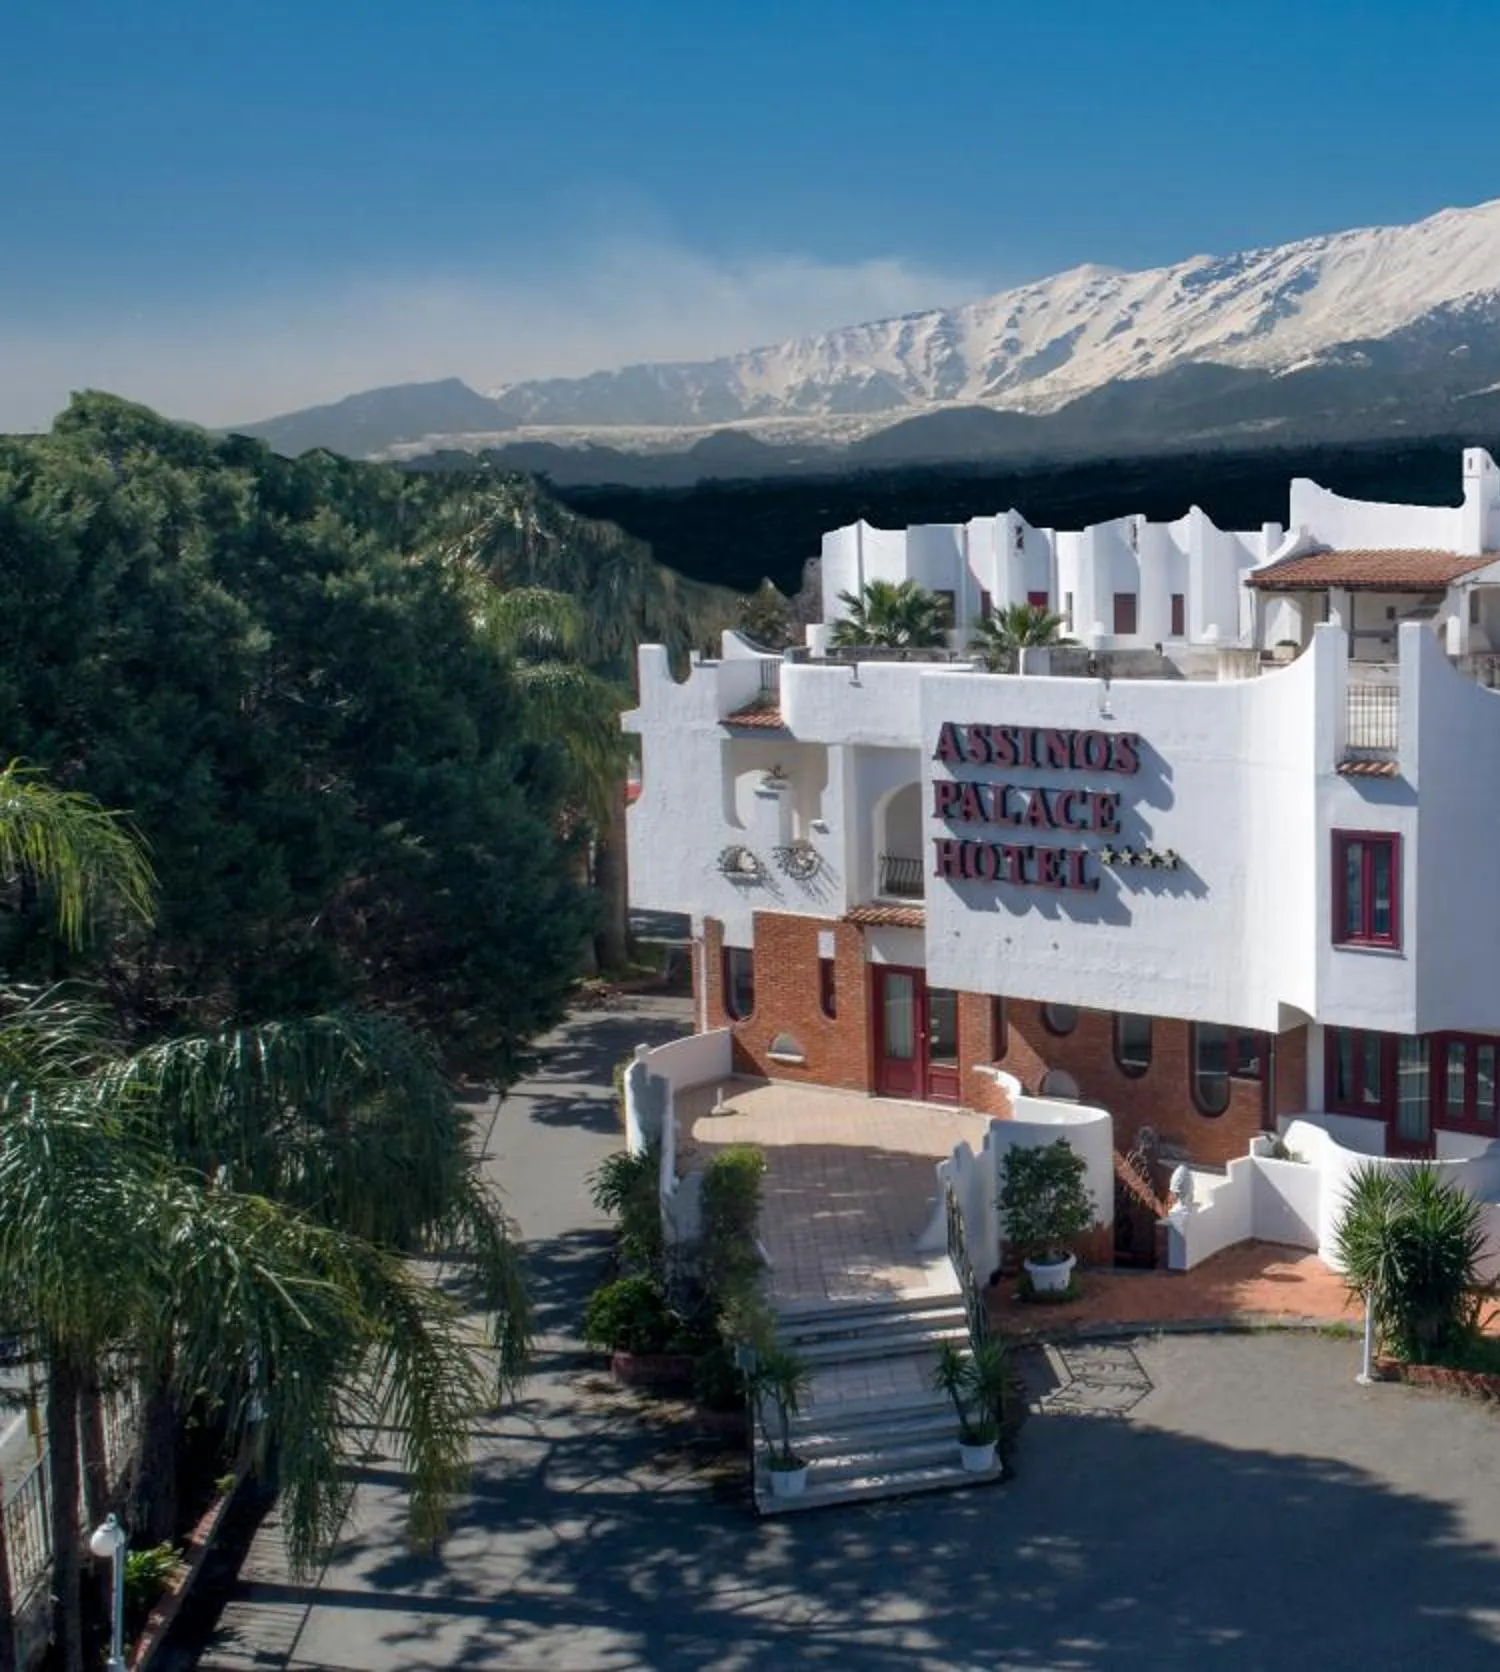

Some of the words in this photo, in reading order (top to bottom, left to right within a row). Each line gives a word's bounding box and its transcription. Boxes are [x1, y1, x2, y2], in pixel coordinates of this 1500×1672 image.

[932, 722, 1141, 774] ASSINOS
[932, 780, 1121, 835] PALACE
[932, 838, 1100, 893] HOTEL
